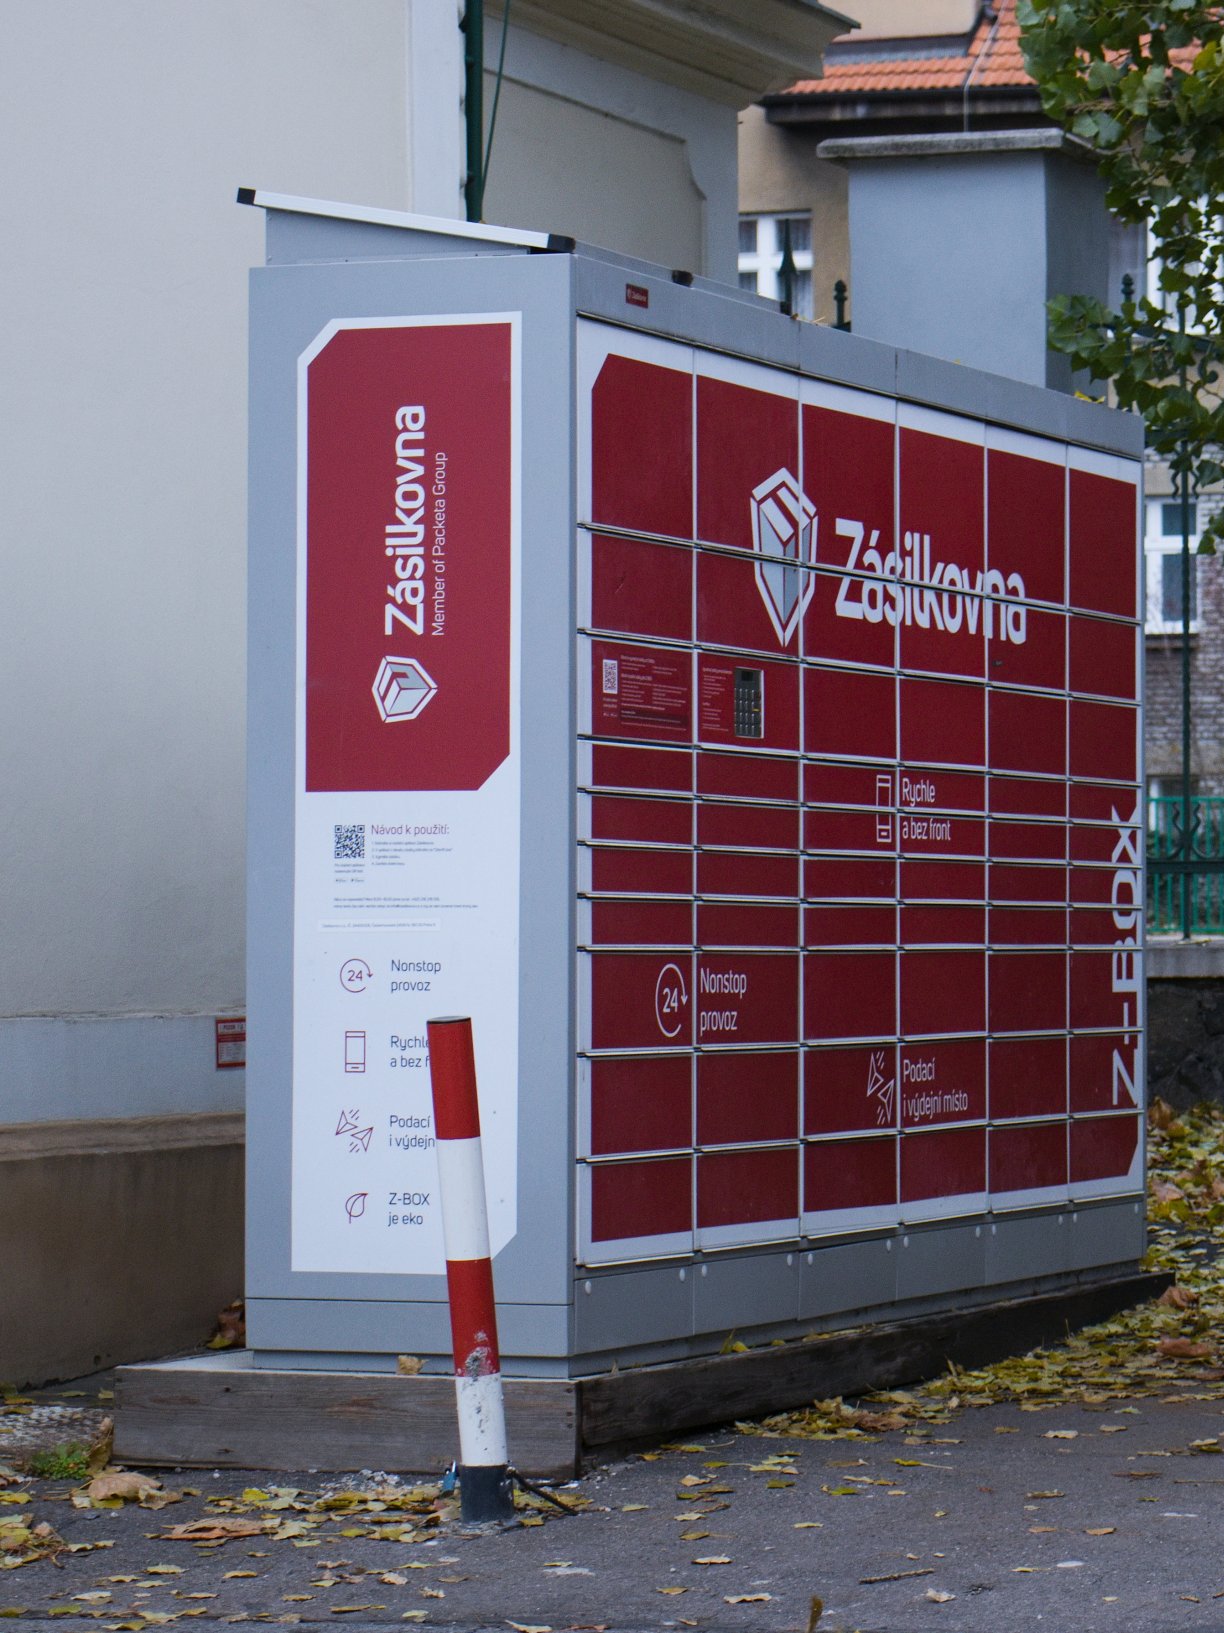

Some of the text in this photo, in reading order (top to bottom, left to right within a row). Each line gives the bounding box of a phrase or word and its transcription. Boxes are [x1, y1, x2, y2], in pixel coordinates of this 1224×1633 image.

[384, 405, 425, 636] Zásilkovna
[432, 452, 448, 636] Member of Packeta Group
[835, 517, 1027, 645] Zásilkovna
[902, 778, 936, 807] Rychle
[371, 824, 450, 836] Návod k použití:
[902, 817, 952, 841] a bez front
[391, 959, 442, 974] Nonstop
[1111, 804, 1138, 1106] Z-BOX
[347, 969, 363, 982] 24
[390, 980, 431, 993] provoz
[700, 967, 747, 999] Nonstop
[662, 987, 679, 1013] 24
[700, 1011, 738, 1037] provoz
[390, 1057, 397, 1068] a
[400, 1055, 422, 1068] bez
[903, 1057, 936, 1083] Podací
[907, 1090, 942, 1122] výdejní
[943, 1088, 969, 1113] místo
[390, 1114, 431, 1128] Podací
[395, 1134, 436, 1150] výdejn
[389, 1192, 430, 1206] Z-BOX
[388, 1211, 424, 1227] je eko
